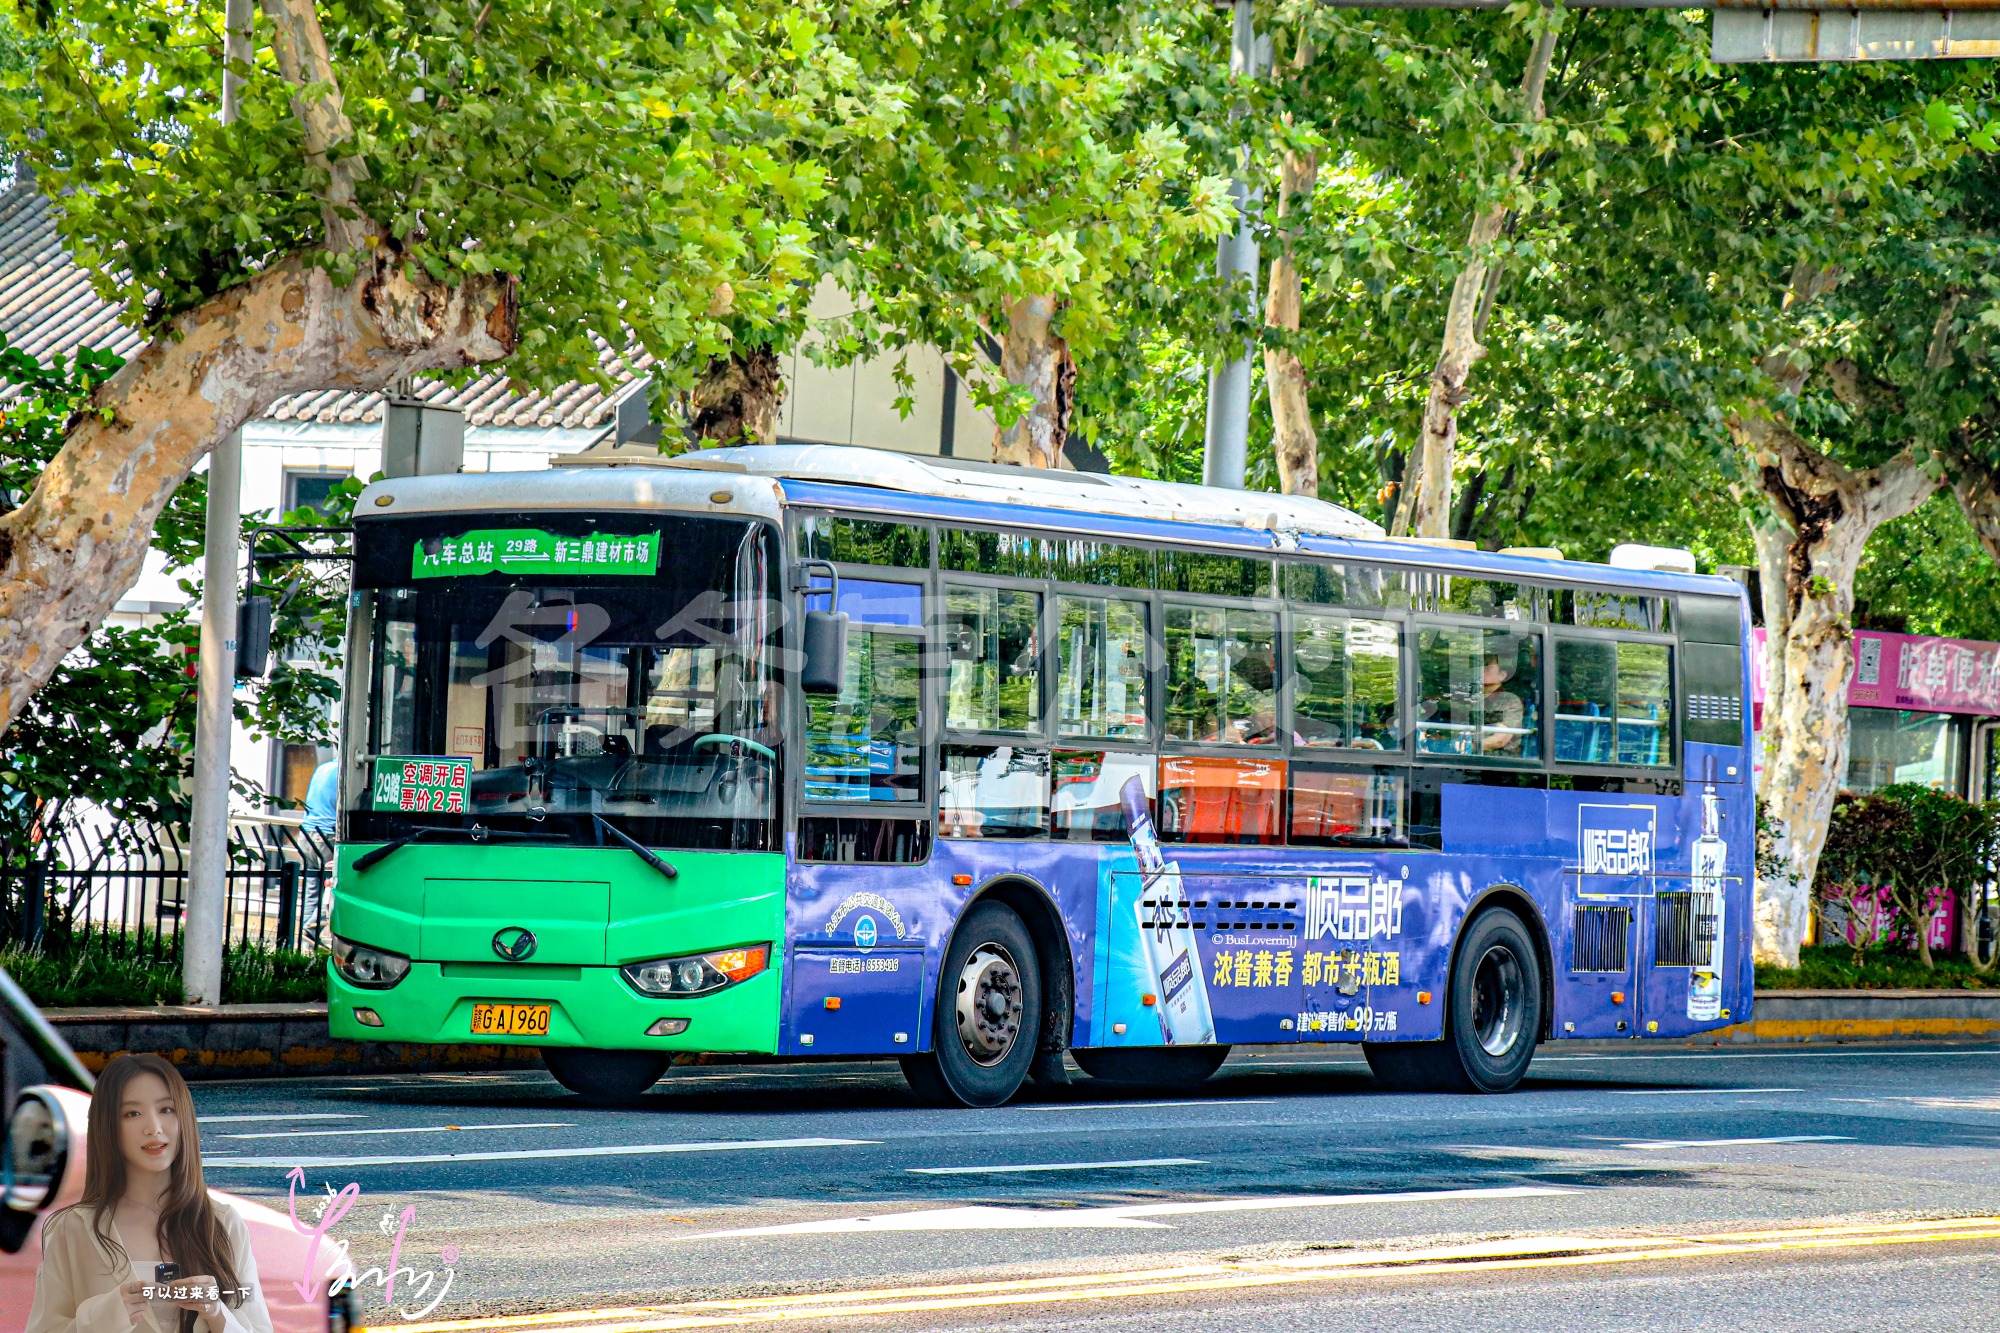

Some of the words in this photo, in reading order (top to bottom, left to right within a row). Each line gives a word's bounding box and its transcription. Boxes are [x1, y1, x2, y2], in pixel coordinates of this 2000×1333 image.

[506, 539, 537, 553] 29路
[554, 540, 649, 564] 新三鼎建材市场
[376, 773, 401, 805] 29路
[402, 762, 467, 788] 空调开启
[399, 787, 464, 813] 票价2元
[1584, 828, 1650, 875] 顺品郎
[825, 892, 906, 939] 九江市公共交通集团公司
[1303, 874, 1403, 940] 顺品郎
[1213, 949, 1294, 987] 浓酱兼香
[1302, 949, 1401, 987] 都市光瓶酒
